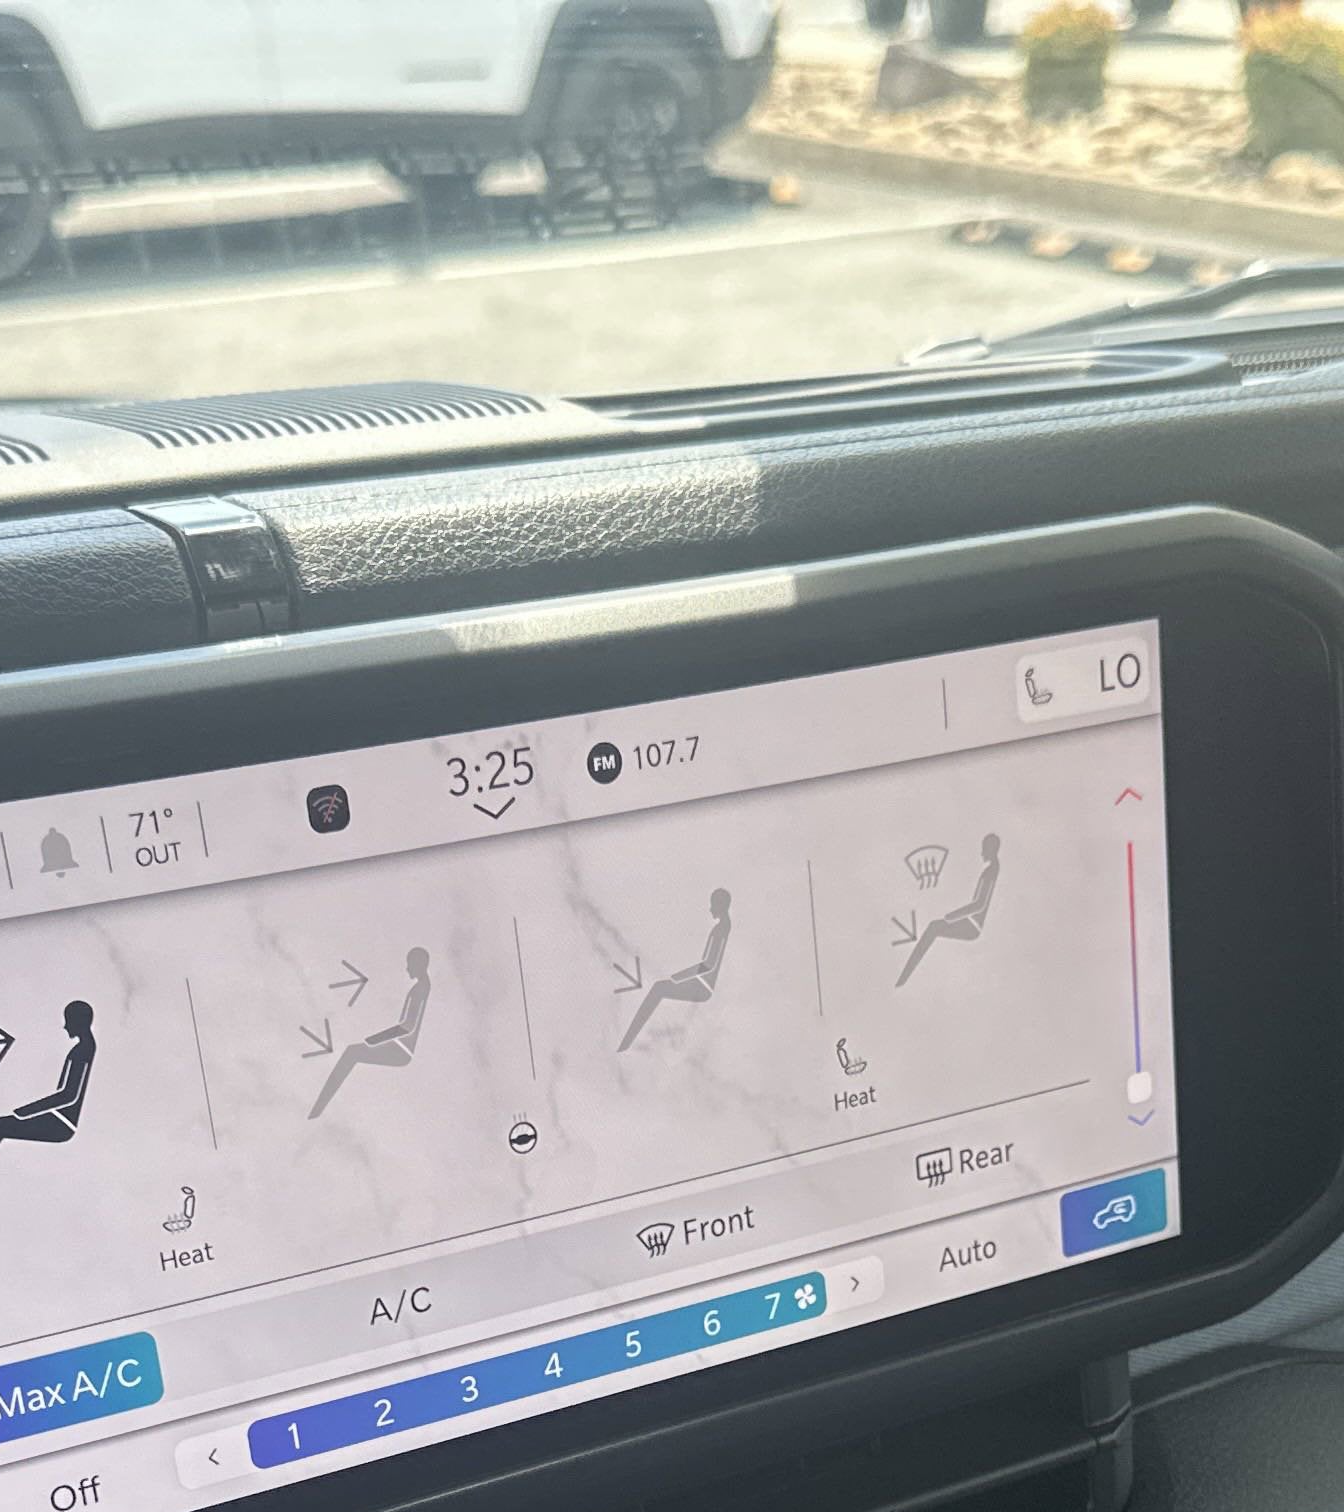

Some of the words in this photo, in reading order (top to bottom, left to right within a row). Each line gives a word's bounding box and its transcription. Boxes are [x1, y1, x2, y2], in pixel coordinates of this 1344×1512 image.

[1099, 653, 1141, 692] LO
[593, 756, 616, 772] FM
[633, 736, 699, 771] 107.7
[446, 747, 534, 797] 3:25
[128, 808, 173, 837] 71°
[136, 842, 181, 867] OUT
[834, 1087, 876, 1111] Heat
[959, 1142, 1014, 1174] Rear
[683, 1205, 755, 1246] Front
[160, 1242, 215, 1271] Heat
[939, 1240, 997, 1272] Auto
[370, 1287, 432, 1325] A/C
[72, 1358, 143, 1402] A/C
[287, 1423, 302, 1451] 1
[374, 1399, 395, 1427] 2
[460, 1376, 479, 1402] 3
[544, 1352, 564, 1379] 4
[625, 1331, 642, 1357] 5
[703, 1309, 721, 1336] 6
[764, 1293, 781, 1320] 7
[50, 1475, 101, 1512] Off
